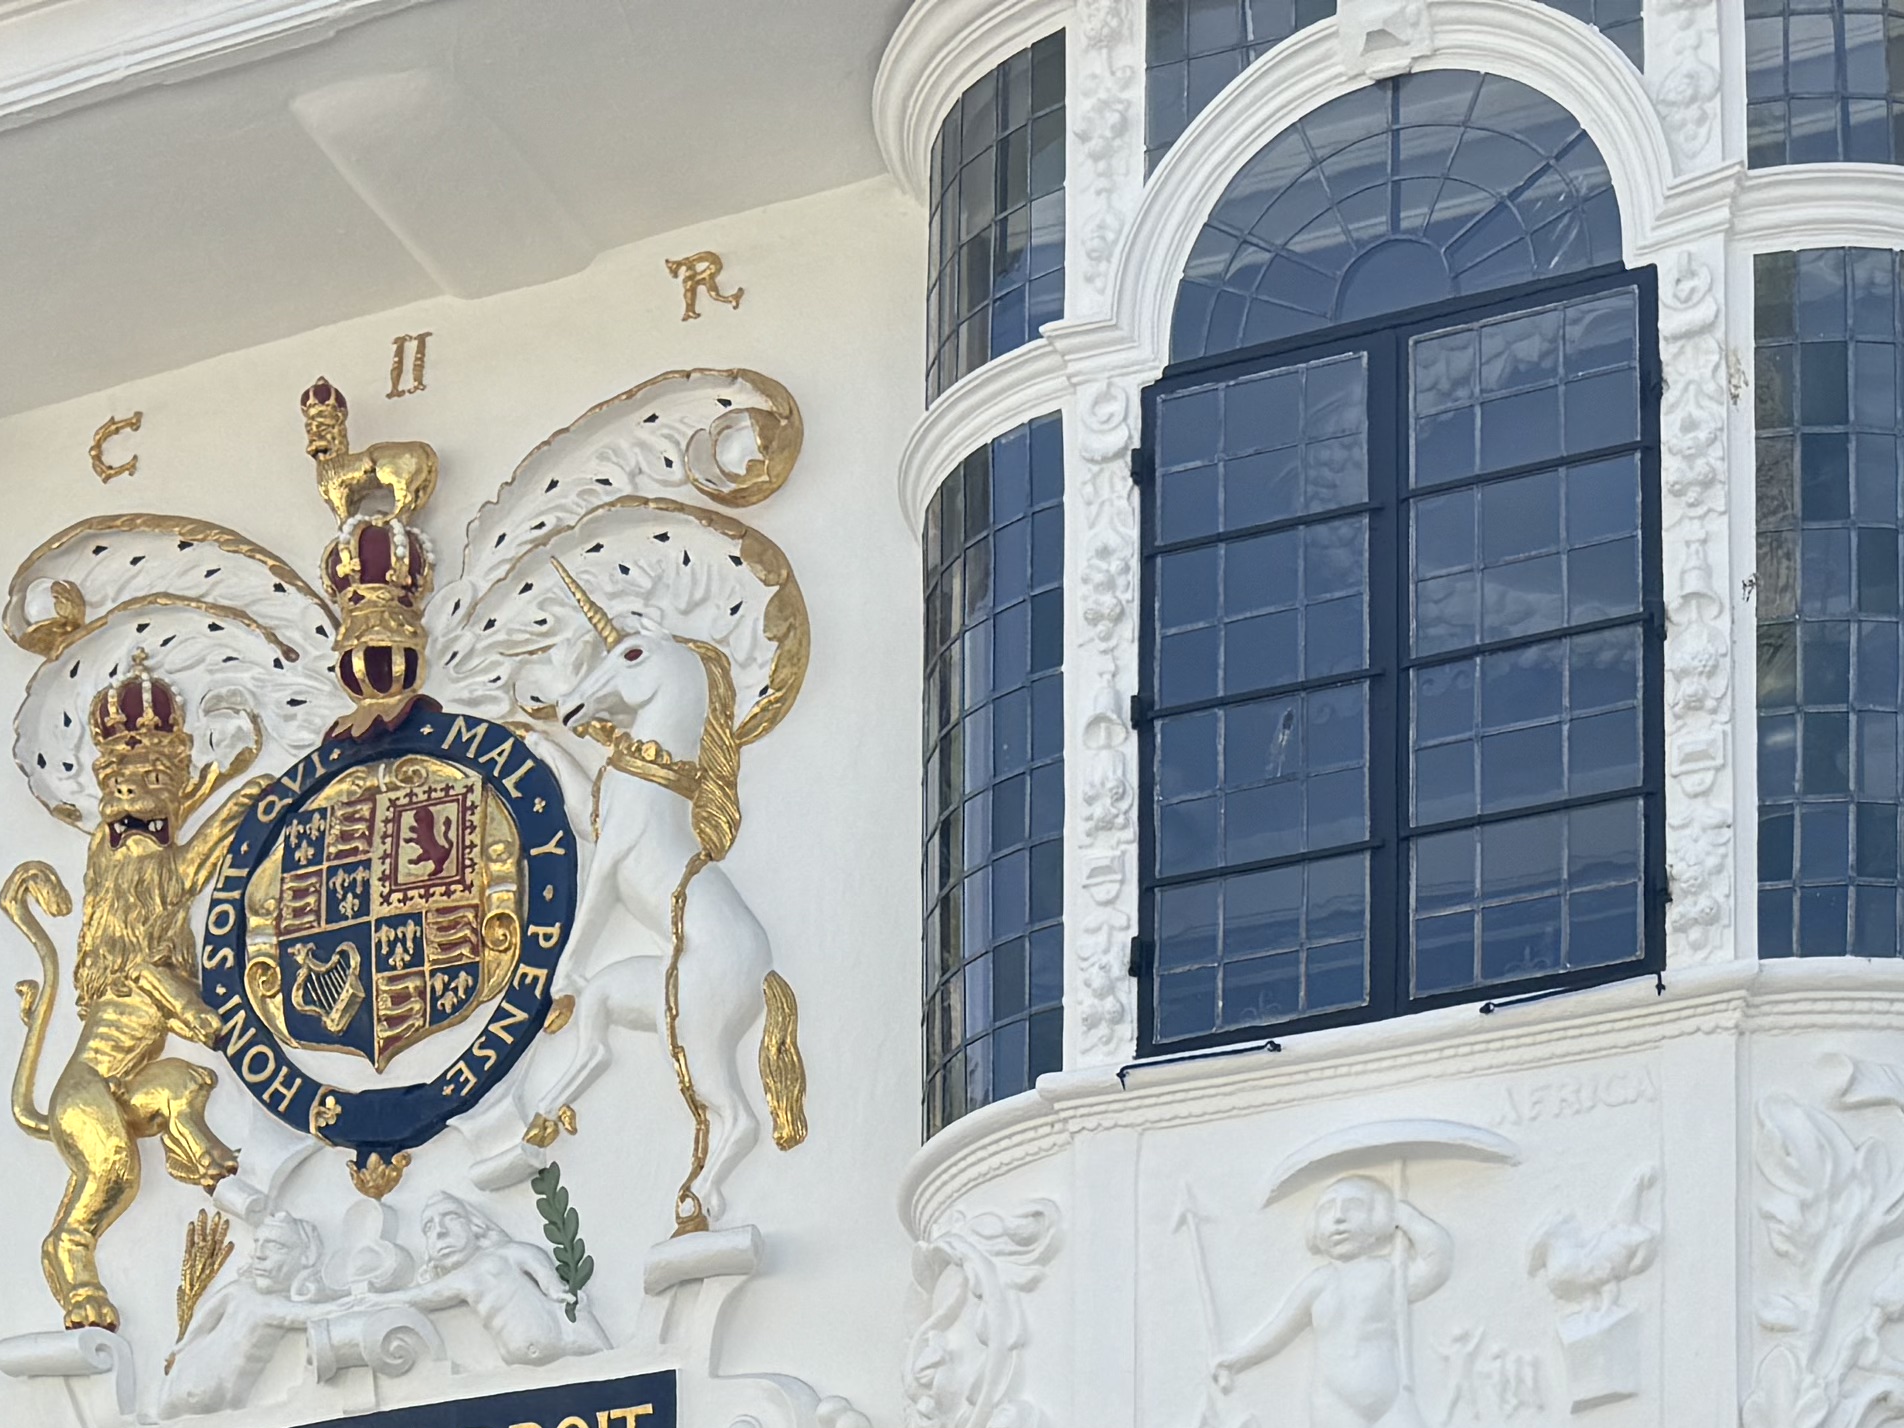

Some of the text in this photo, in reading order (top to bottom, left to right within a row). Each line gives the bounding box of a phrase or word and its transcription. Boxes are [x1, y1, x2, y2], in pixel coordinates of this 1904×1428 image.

[89, 410, 144, 484] C
[665, 250, 745, 322] R
[441, 715, 537, 800] MAL
[530, 829, 566, 857] Y
[203, 852, 248, 970] SOIT
[216, 994, 302, 1113] HONI
[443, 923, 561, 1098] PENSE
